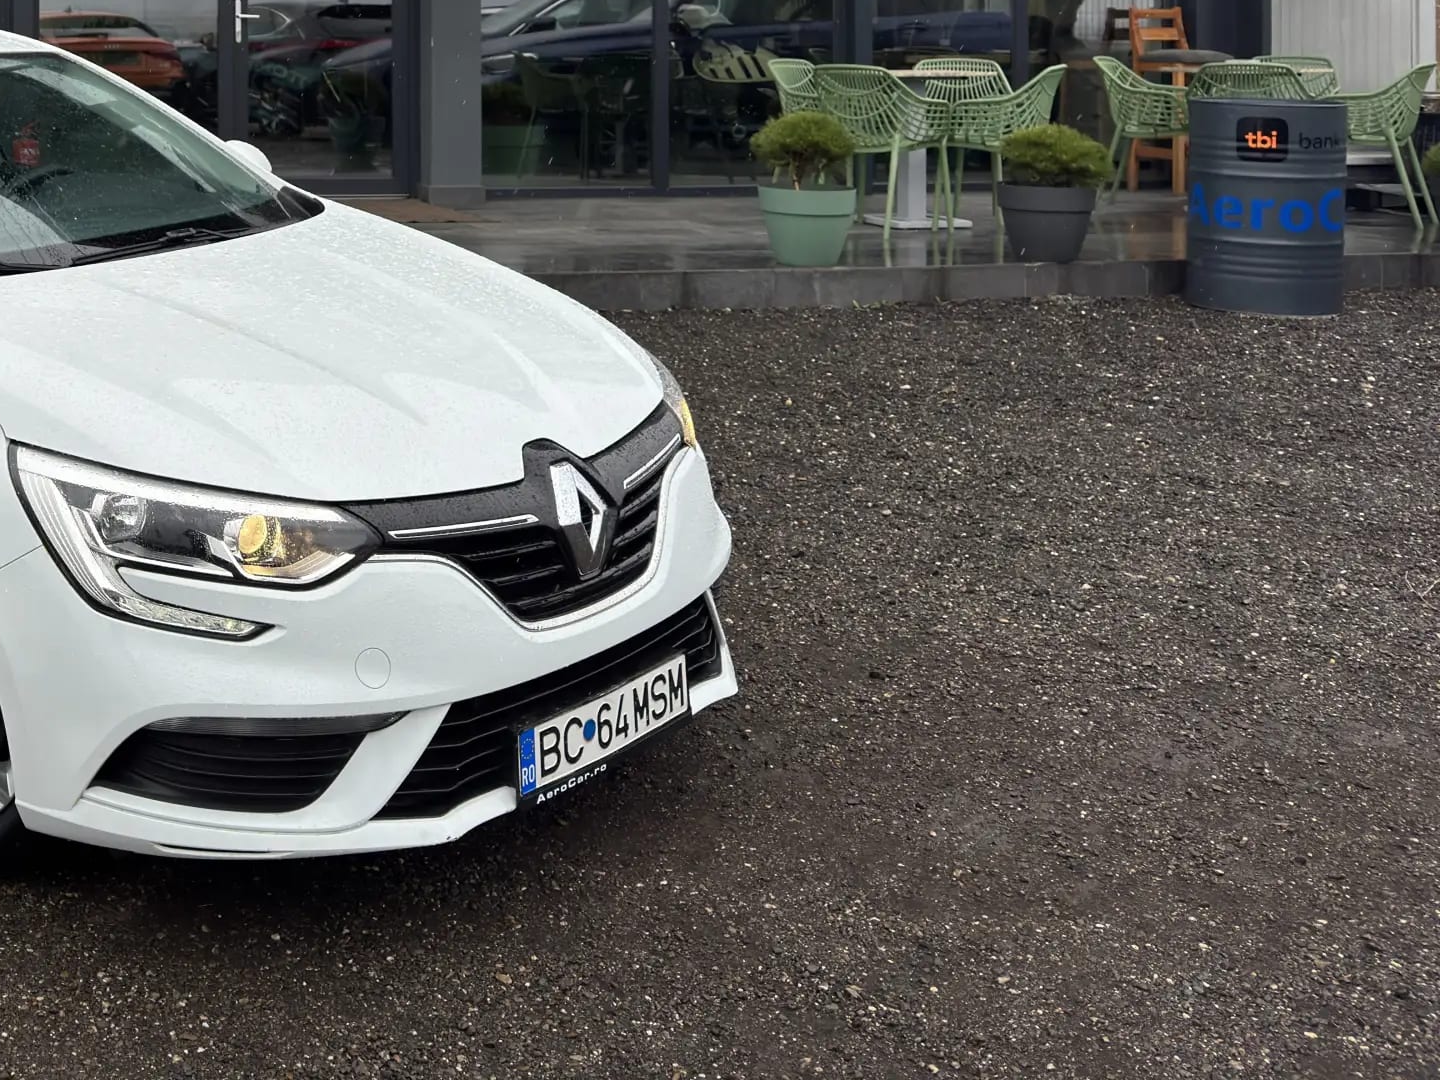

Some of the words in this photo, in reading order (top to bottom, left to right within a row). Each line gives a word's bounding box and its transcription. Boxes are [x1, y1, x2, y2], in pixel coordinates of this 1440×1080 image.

[1244, 131, 1278, 149] tbi
[521, 763, 535, 788] RO
[536, 763, 607, 805] AeroCar.ro
